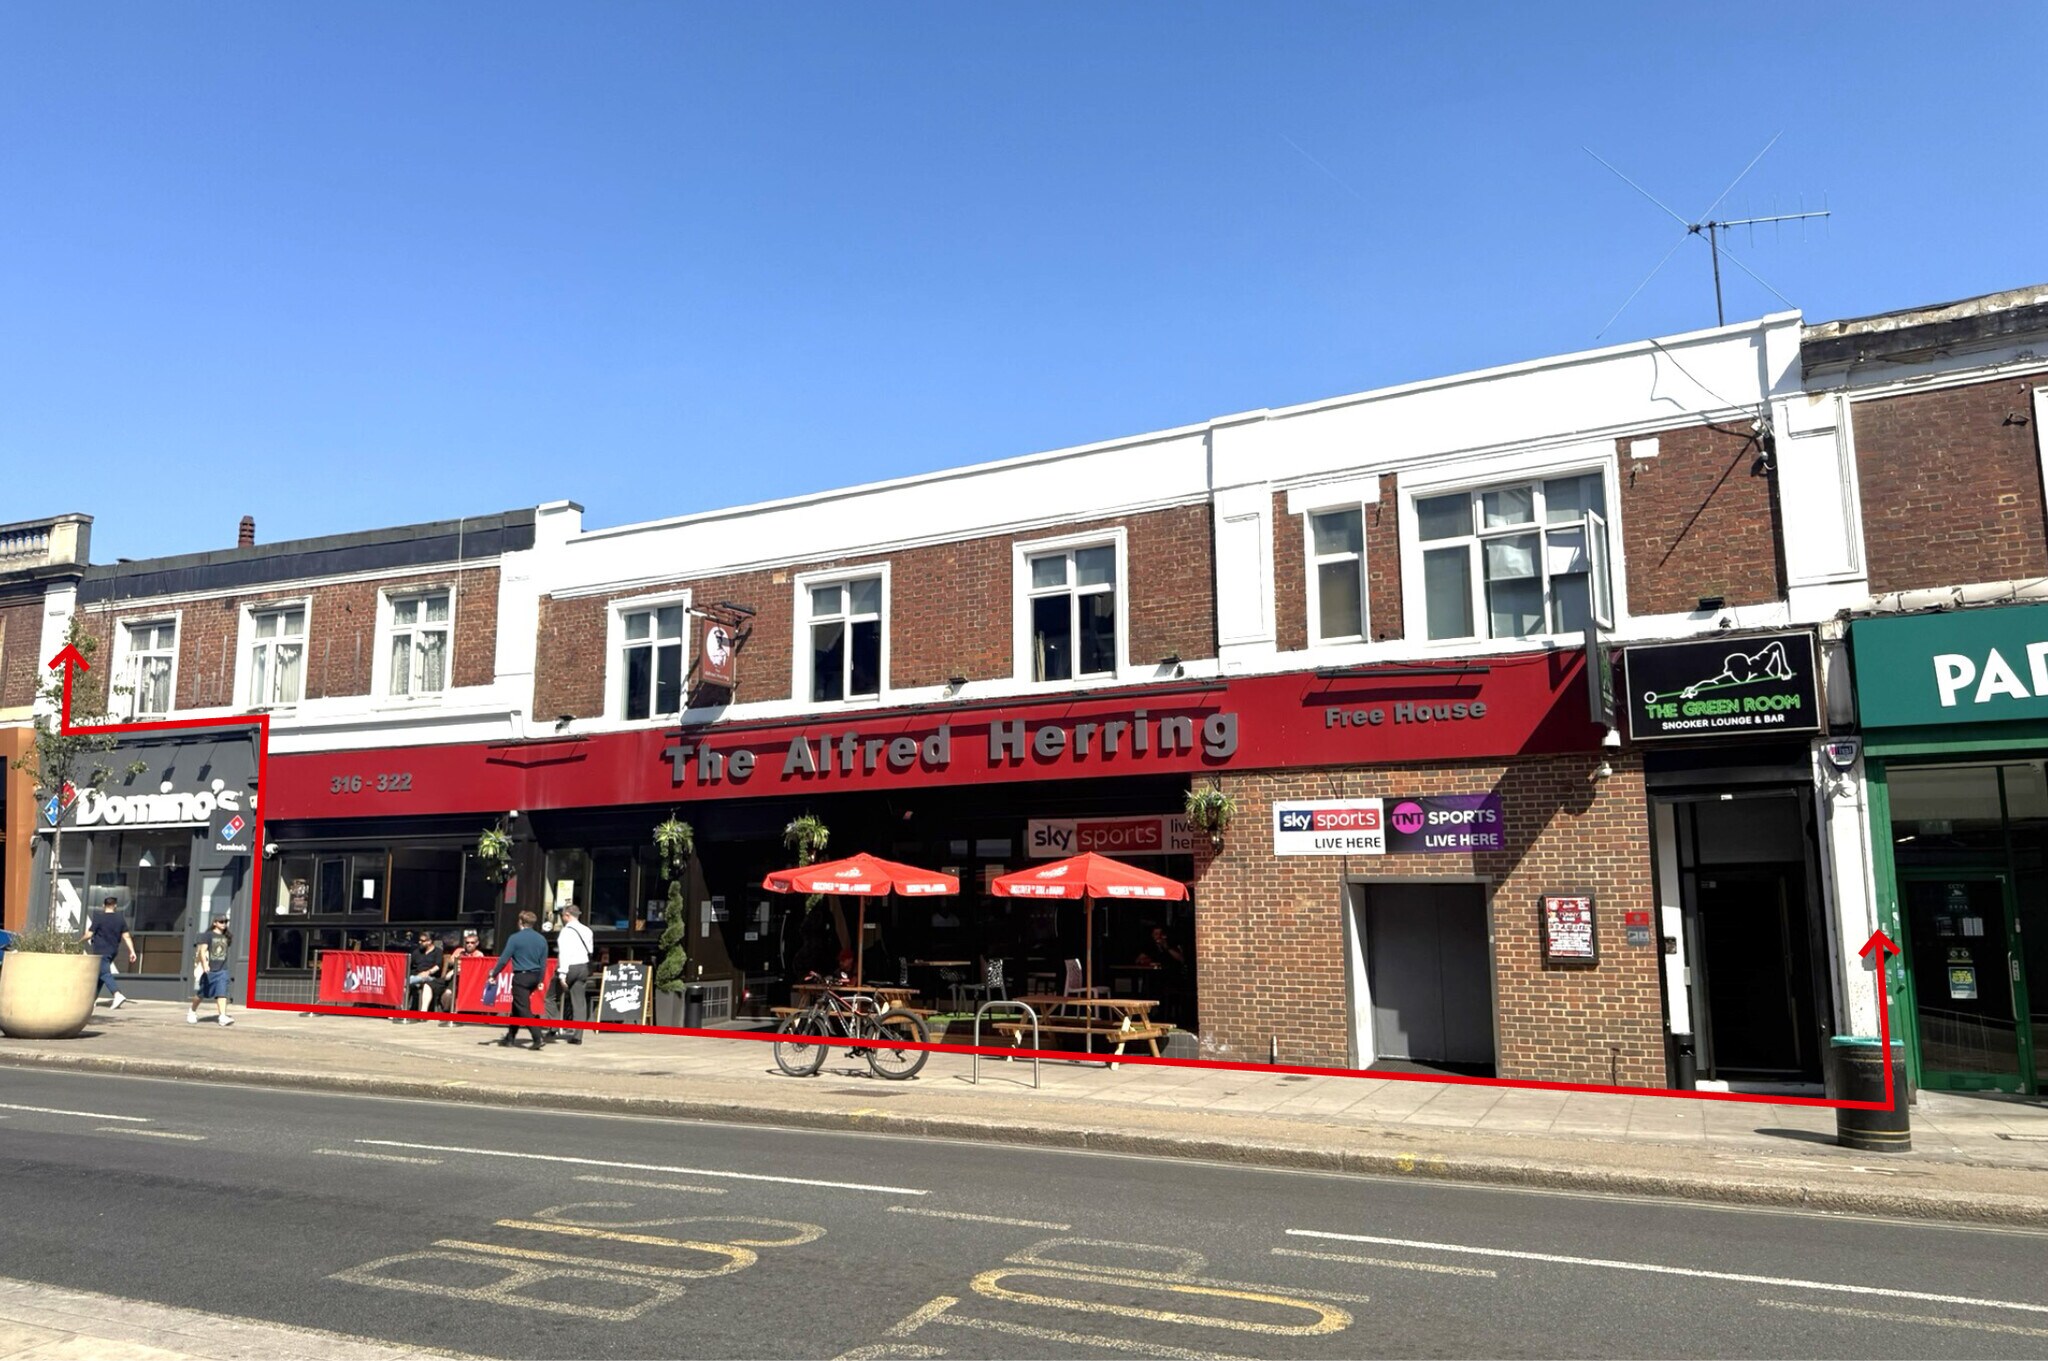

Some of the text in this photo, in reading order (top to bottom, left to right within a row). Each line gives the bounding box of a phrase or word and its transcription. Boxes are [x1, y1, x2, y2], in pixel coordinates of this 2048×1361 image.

[1326, 702, 1487, 728] Free House
[1645, 694, 1801, 719] THE GREEN ROOM
[1662, 714, 1785, 730] SNOOKER LOUNGE & BAR
[666, 710, 1238, 781] The Alfred Herring
[330, 775, 362, 794] 316
[376, 772, 412, 792] 322
[76, 779, 240, 826] Domino's
[1283, 811, 1377, 830] sky sports
[1392, 809, 1496, 826] TNT SPORTS
[1034, 825, 1157, 851] sky sports
[1315, 836, 1382, 849] LIVE HERE
[1425, 833, 1499, 847] LIVE HERE
[324, 1201, 828, 1322] BUS
[830, 1236, 1372, 1361] TOP
